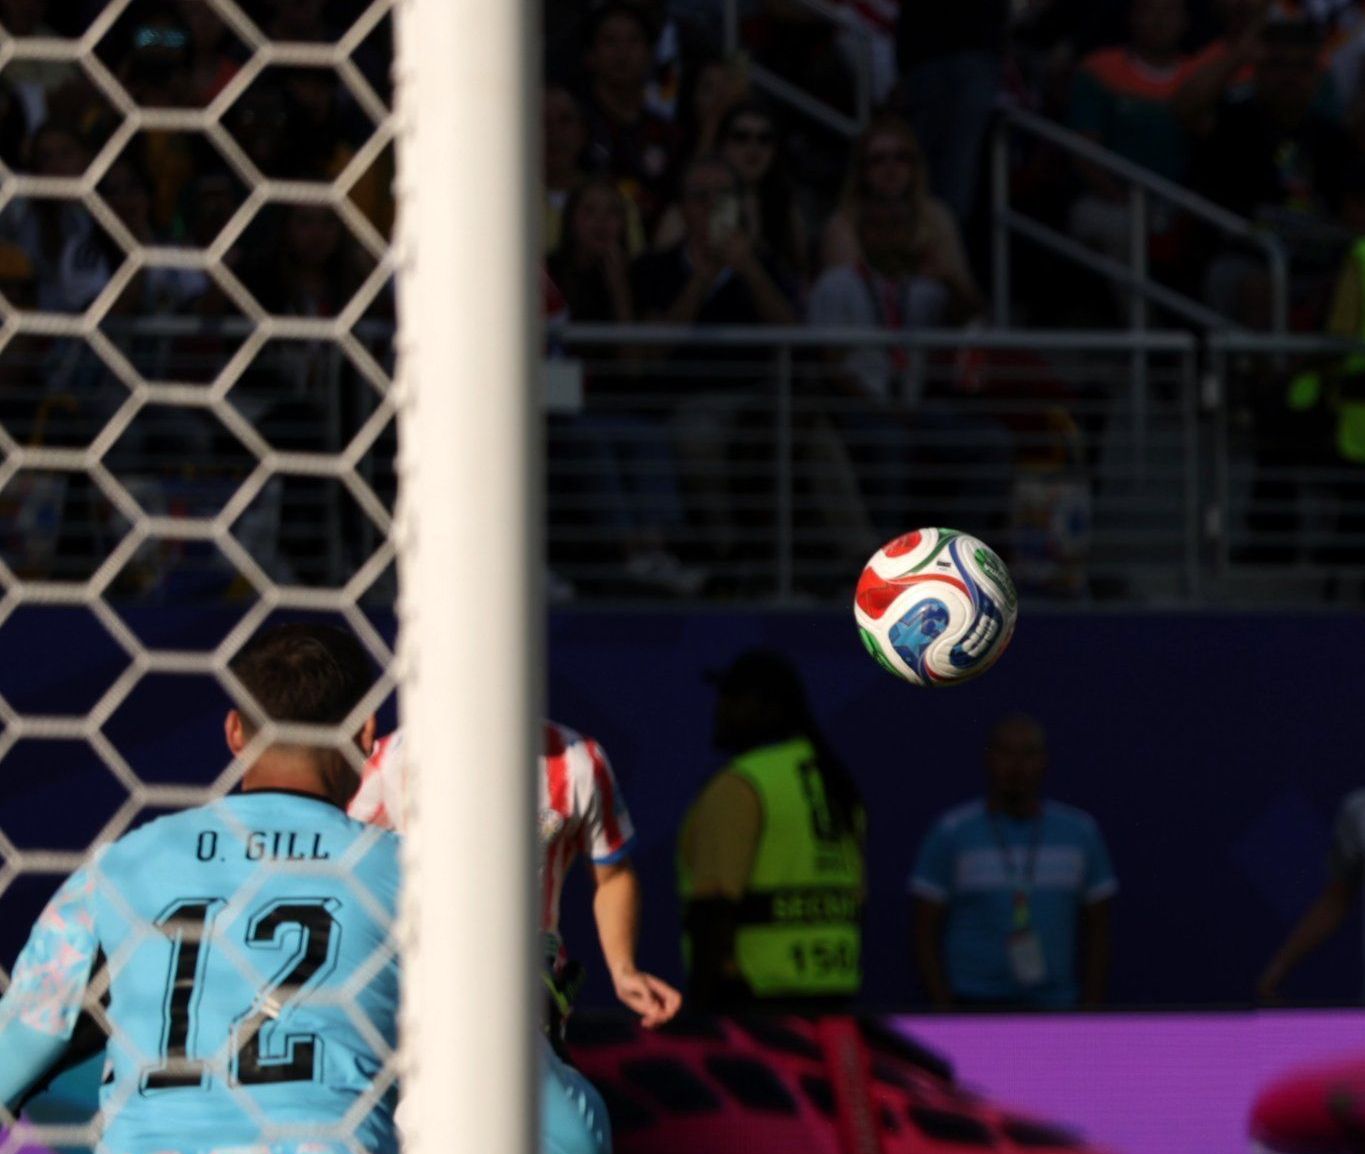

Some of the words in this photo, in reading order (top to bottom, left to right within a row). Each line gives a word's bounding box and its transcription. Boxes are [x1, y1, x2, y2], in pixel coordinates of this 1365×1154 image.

[196, 829, 226, 863] O.
[245, 829, 331, 863] GILL
[138, 895, 344, 1098] 12
